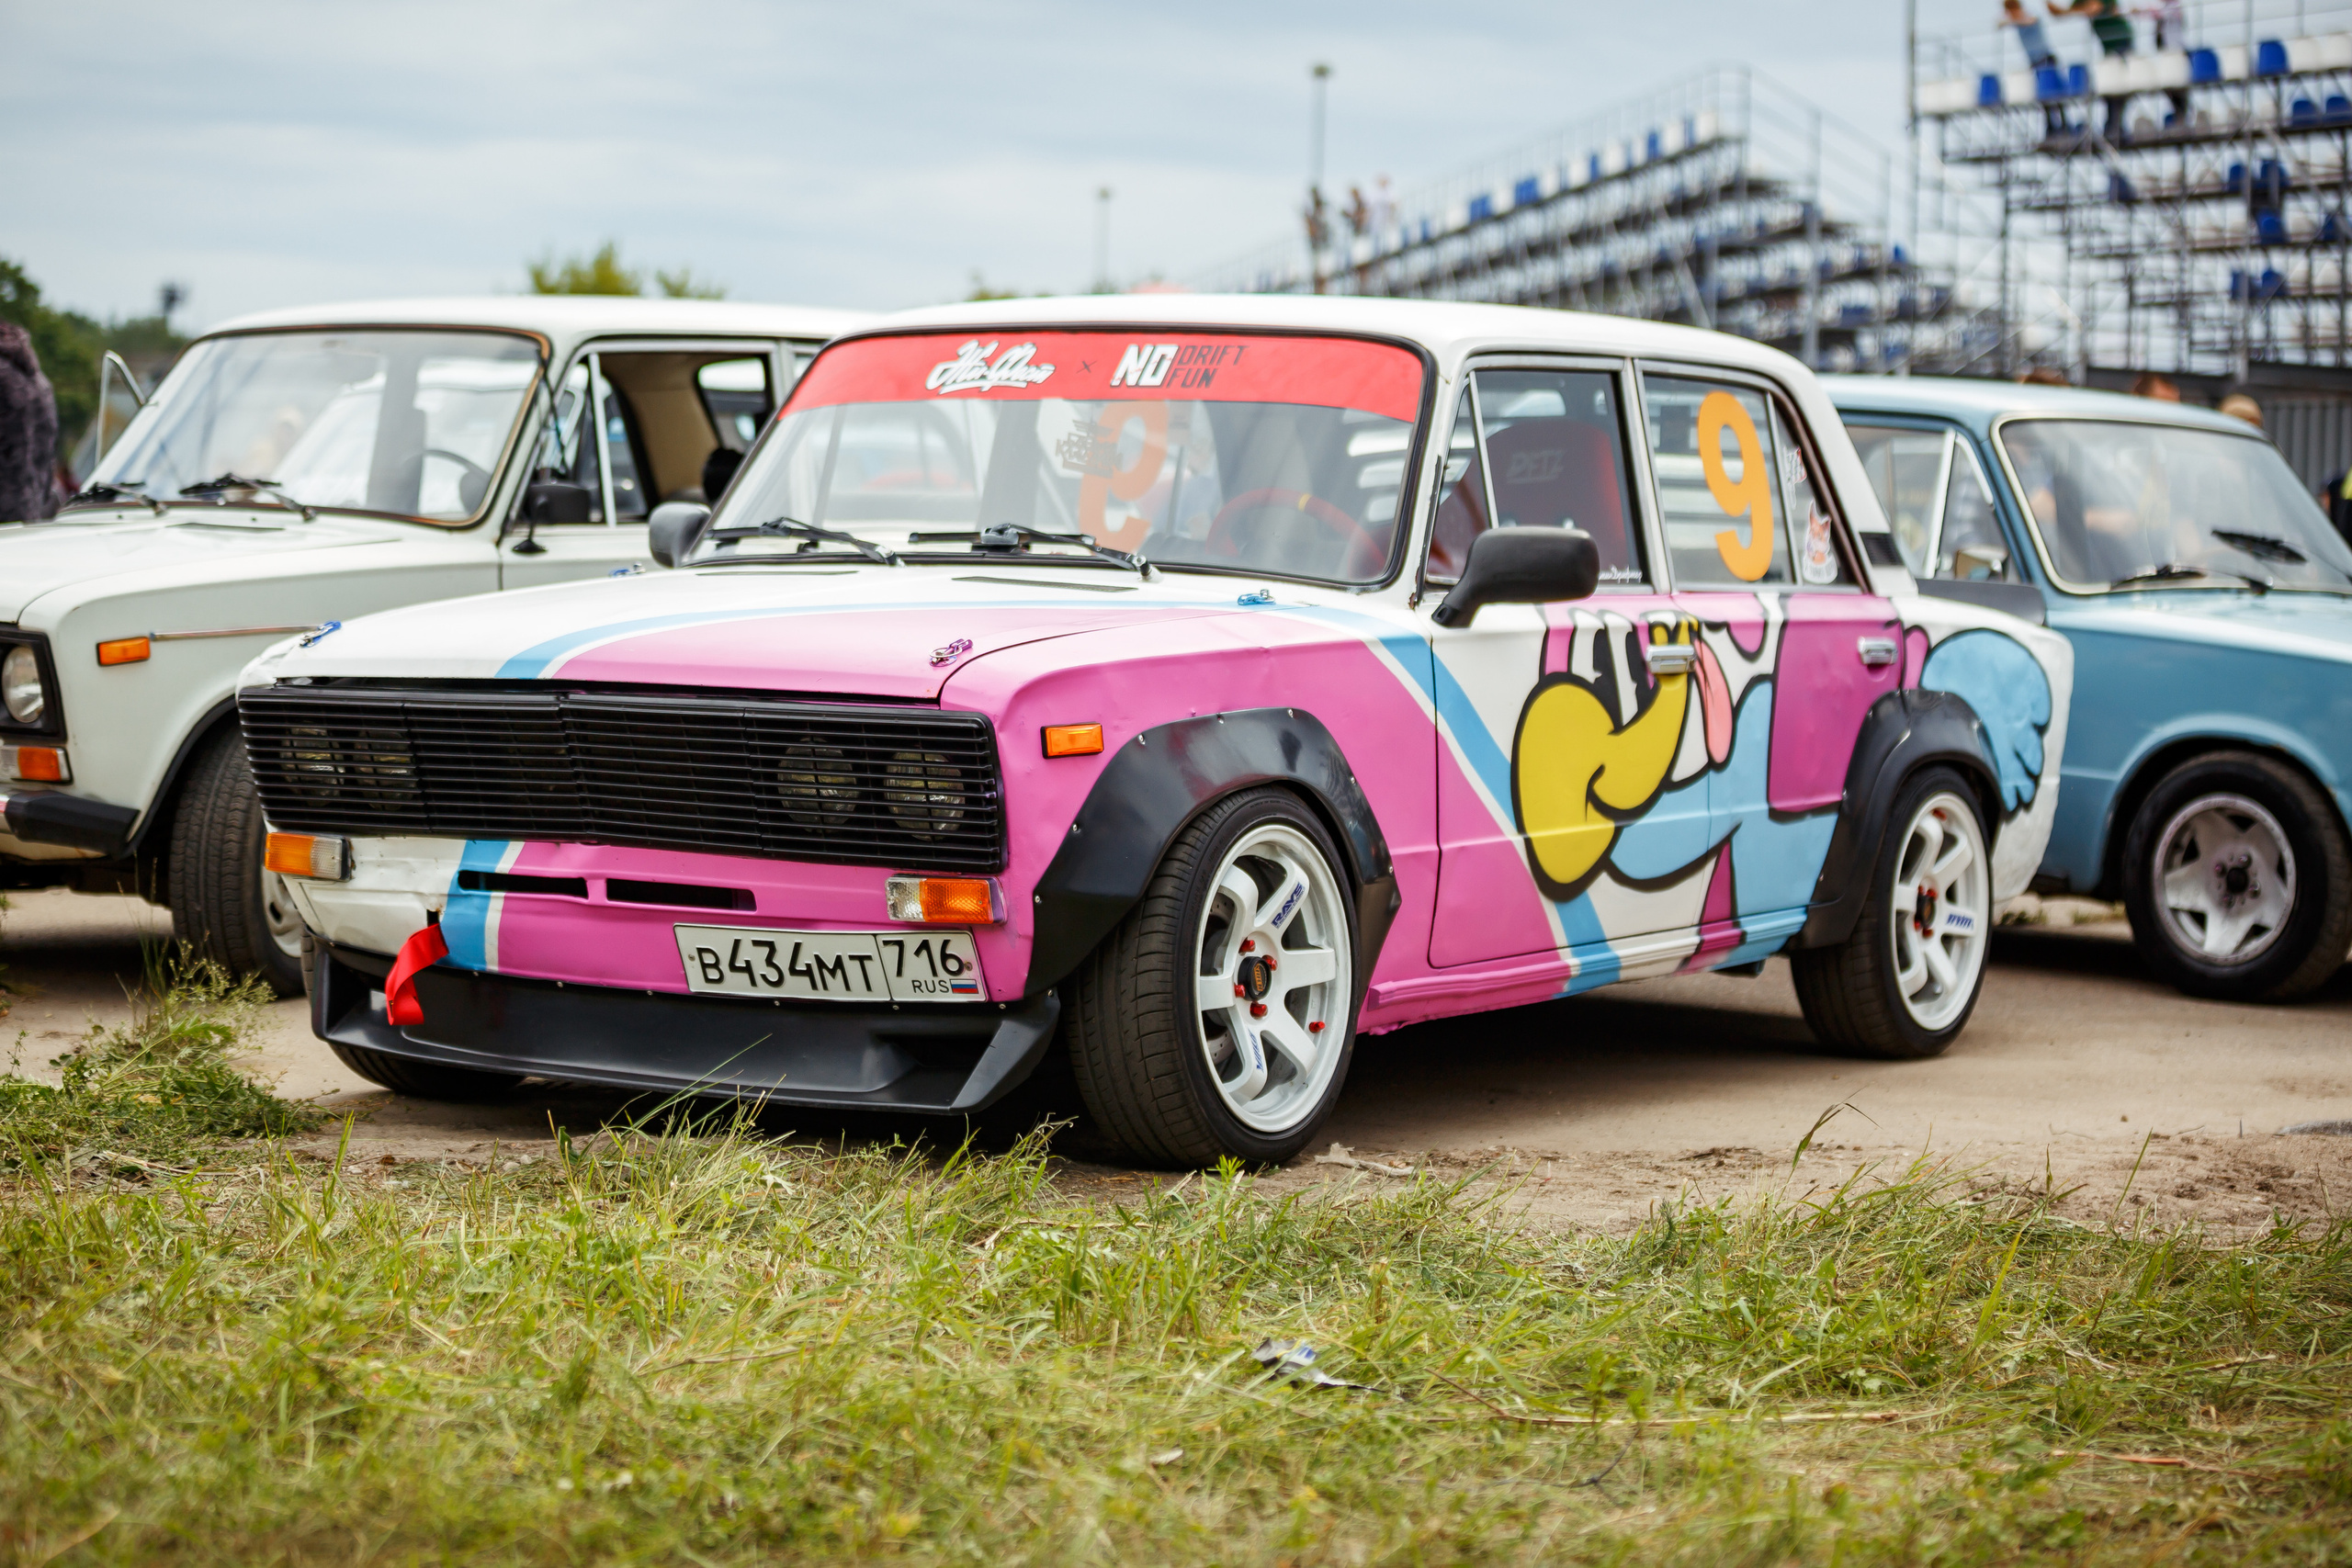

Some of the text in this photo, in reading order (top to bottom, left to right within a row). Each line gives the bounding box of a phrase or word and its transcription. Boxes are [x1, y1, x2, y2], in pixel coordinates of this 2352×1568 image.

[1110, 344, 1179, 388] NO
[1177, 344, 1250, 366] DRIFT
[1166, 368, 1217, 389] FUN
[1698, 389, 1774, 581] 9
[1271, 881, 1304, 927] RAYS
[882, 938, 965, 977] 716
[911, 979, 949, 994] RUS
